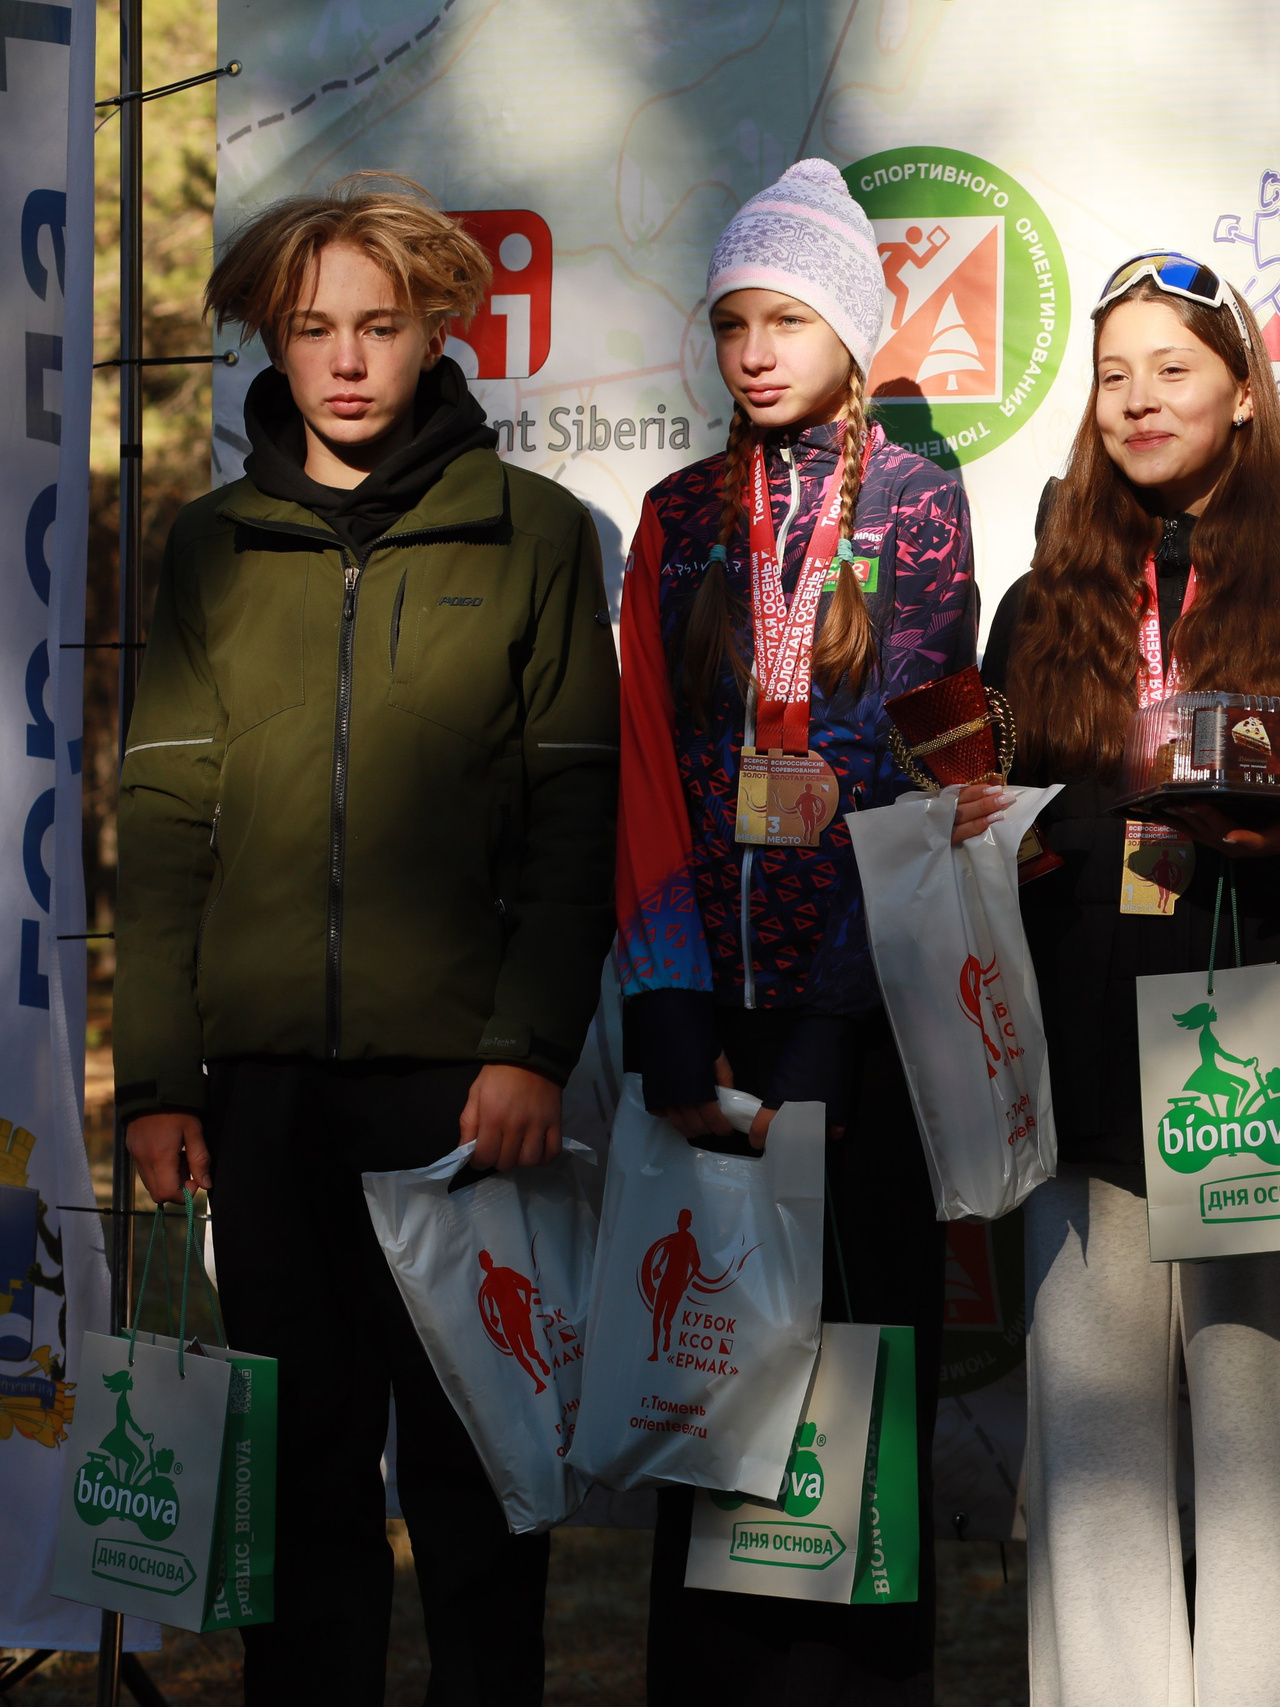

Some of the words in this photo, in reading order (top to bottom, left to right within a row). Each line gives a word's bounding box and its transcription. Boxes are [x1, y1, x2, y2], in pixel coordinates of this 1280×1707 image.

[861, 163, 1009, 208] СПОРТИВНОГО
[999, 217, 1056, 418] ОРИЕНТИРОВАНИЯ
[547, 404, 690, 452] Siberia
[761, 561, 776, 614] ОСЕНЬ
[774, 627, 804, 703] ЗОЛОТАЯ
[796, 570, 820, 623] ОСЕНЬ
[1146, 619, 1162, 675] ОСЕНЬ
[767, 816, 780, 833] 3
[767, 835, 802, 844] МЕСТО
[1124, 883, 1134, 901] 1
[1121, 903, 1156, 912] МЕСТО
[1207, 1189, 1249, 1211] ДНЯ
[682, 1310, 737, 1334] КУБОК
[678, 1331, 714, 1351] КСО
[666, 1352, 739, 1375] «ЕРМАК»
[640, 1395, 707, 1416] г.Тюмень
[77, 1468, 178, 1526] bionova
[736, 1531, 770, 1550] ДНЯ
[772, 1534, 833, 1555] ОСНОВА
[97, 1546, 127, 1569] ДНЯ
[128, 1554, 185, 1583] ОСНОВА
